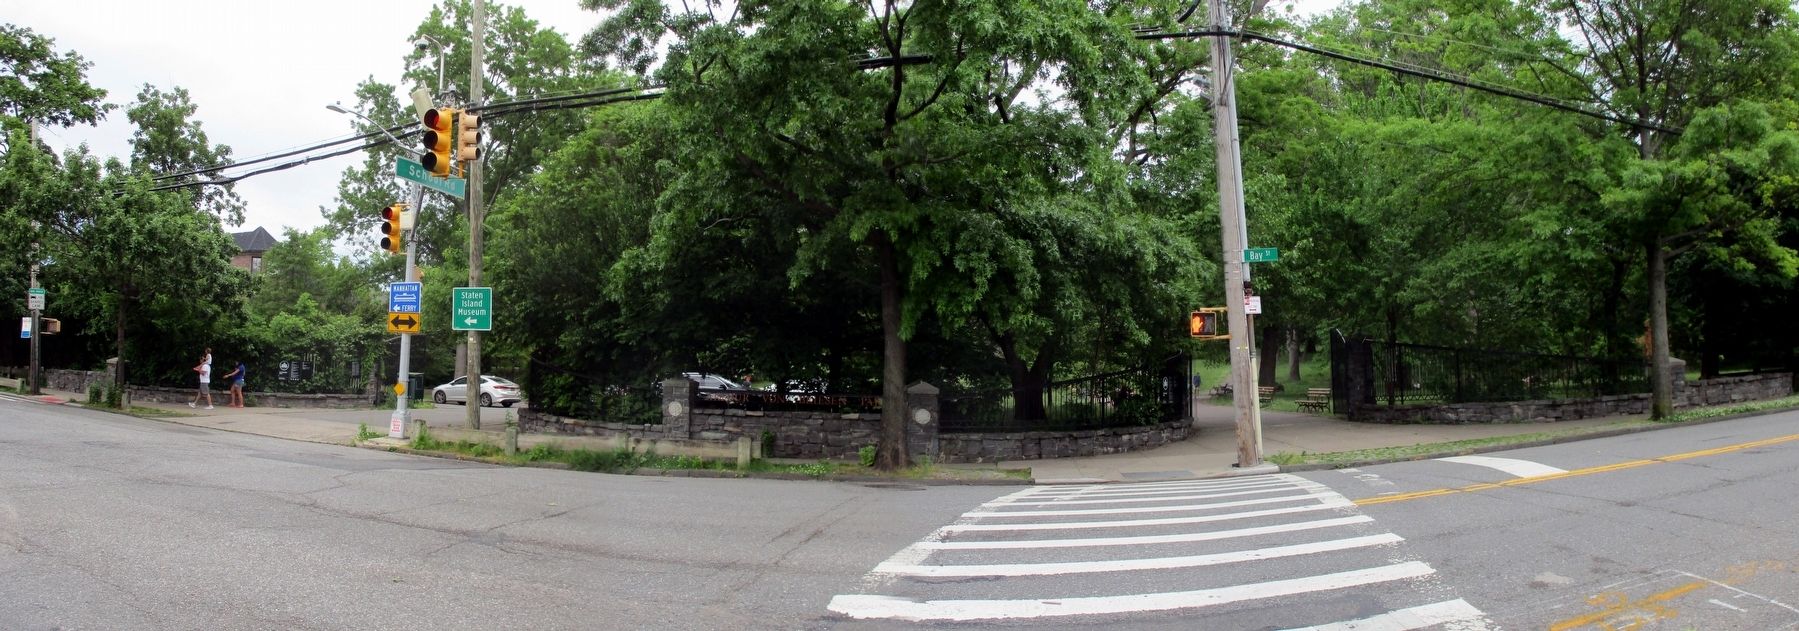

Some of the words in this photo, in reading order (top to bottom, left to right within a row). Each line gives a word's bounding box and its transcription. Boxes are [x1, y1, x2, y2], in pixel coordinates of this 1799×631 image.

[1249, 251, 1263, 261] Bay
[461, 291, 484, 299] Staten
[401, 304, 417, 312] FERRY
[457, 308, 487, 316] Museum
